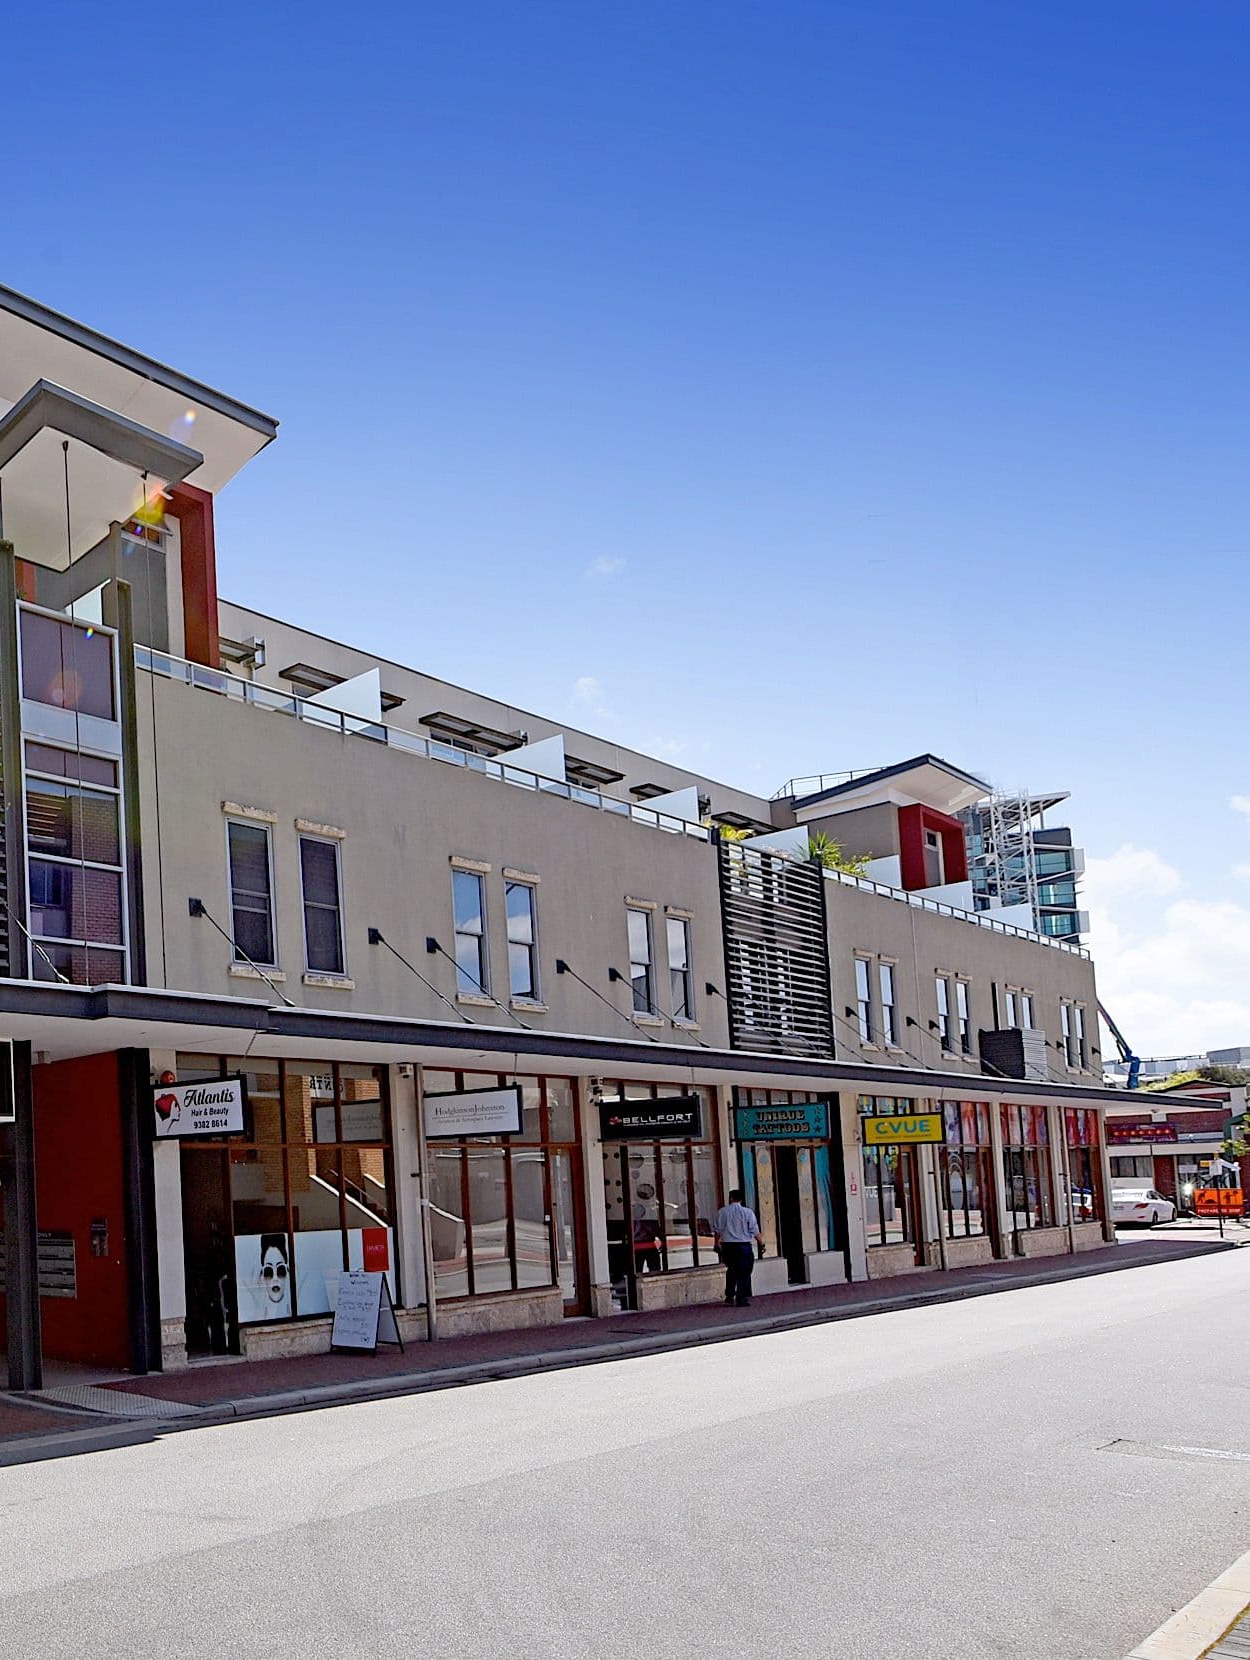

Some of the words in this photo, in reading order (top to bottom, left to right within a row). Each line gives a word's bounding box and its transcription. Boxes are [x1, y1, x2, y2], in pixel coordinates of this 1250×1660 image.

[184, 1088, 234, 1107] Atlantis
[191, 1109, 202, 1117] Hair
[203, 1108, 208, 1116] &
[210, 1107, 229, 1116] Beauty
[757, 1110, 805, 1122] UNIQUE
[622, 1113, 693, 1124] BELLFORT
[193, 1121, 210, 1129] 9382
[753, 1122, 810, 1135] TATTOOS
[875, 1119, 931, 1135] CVUE
